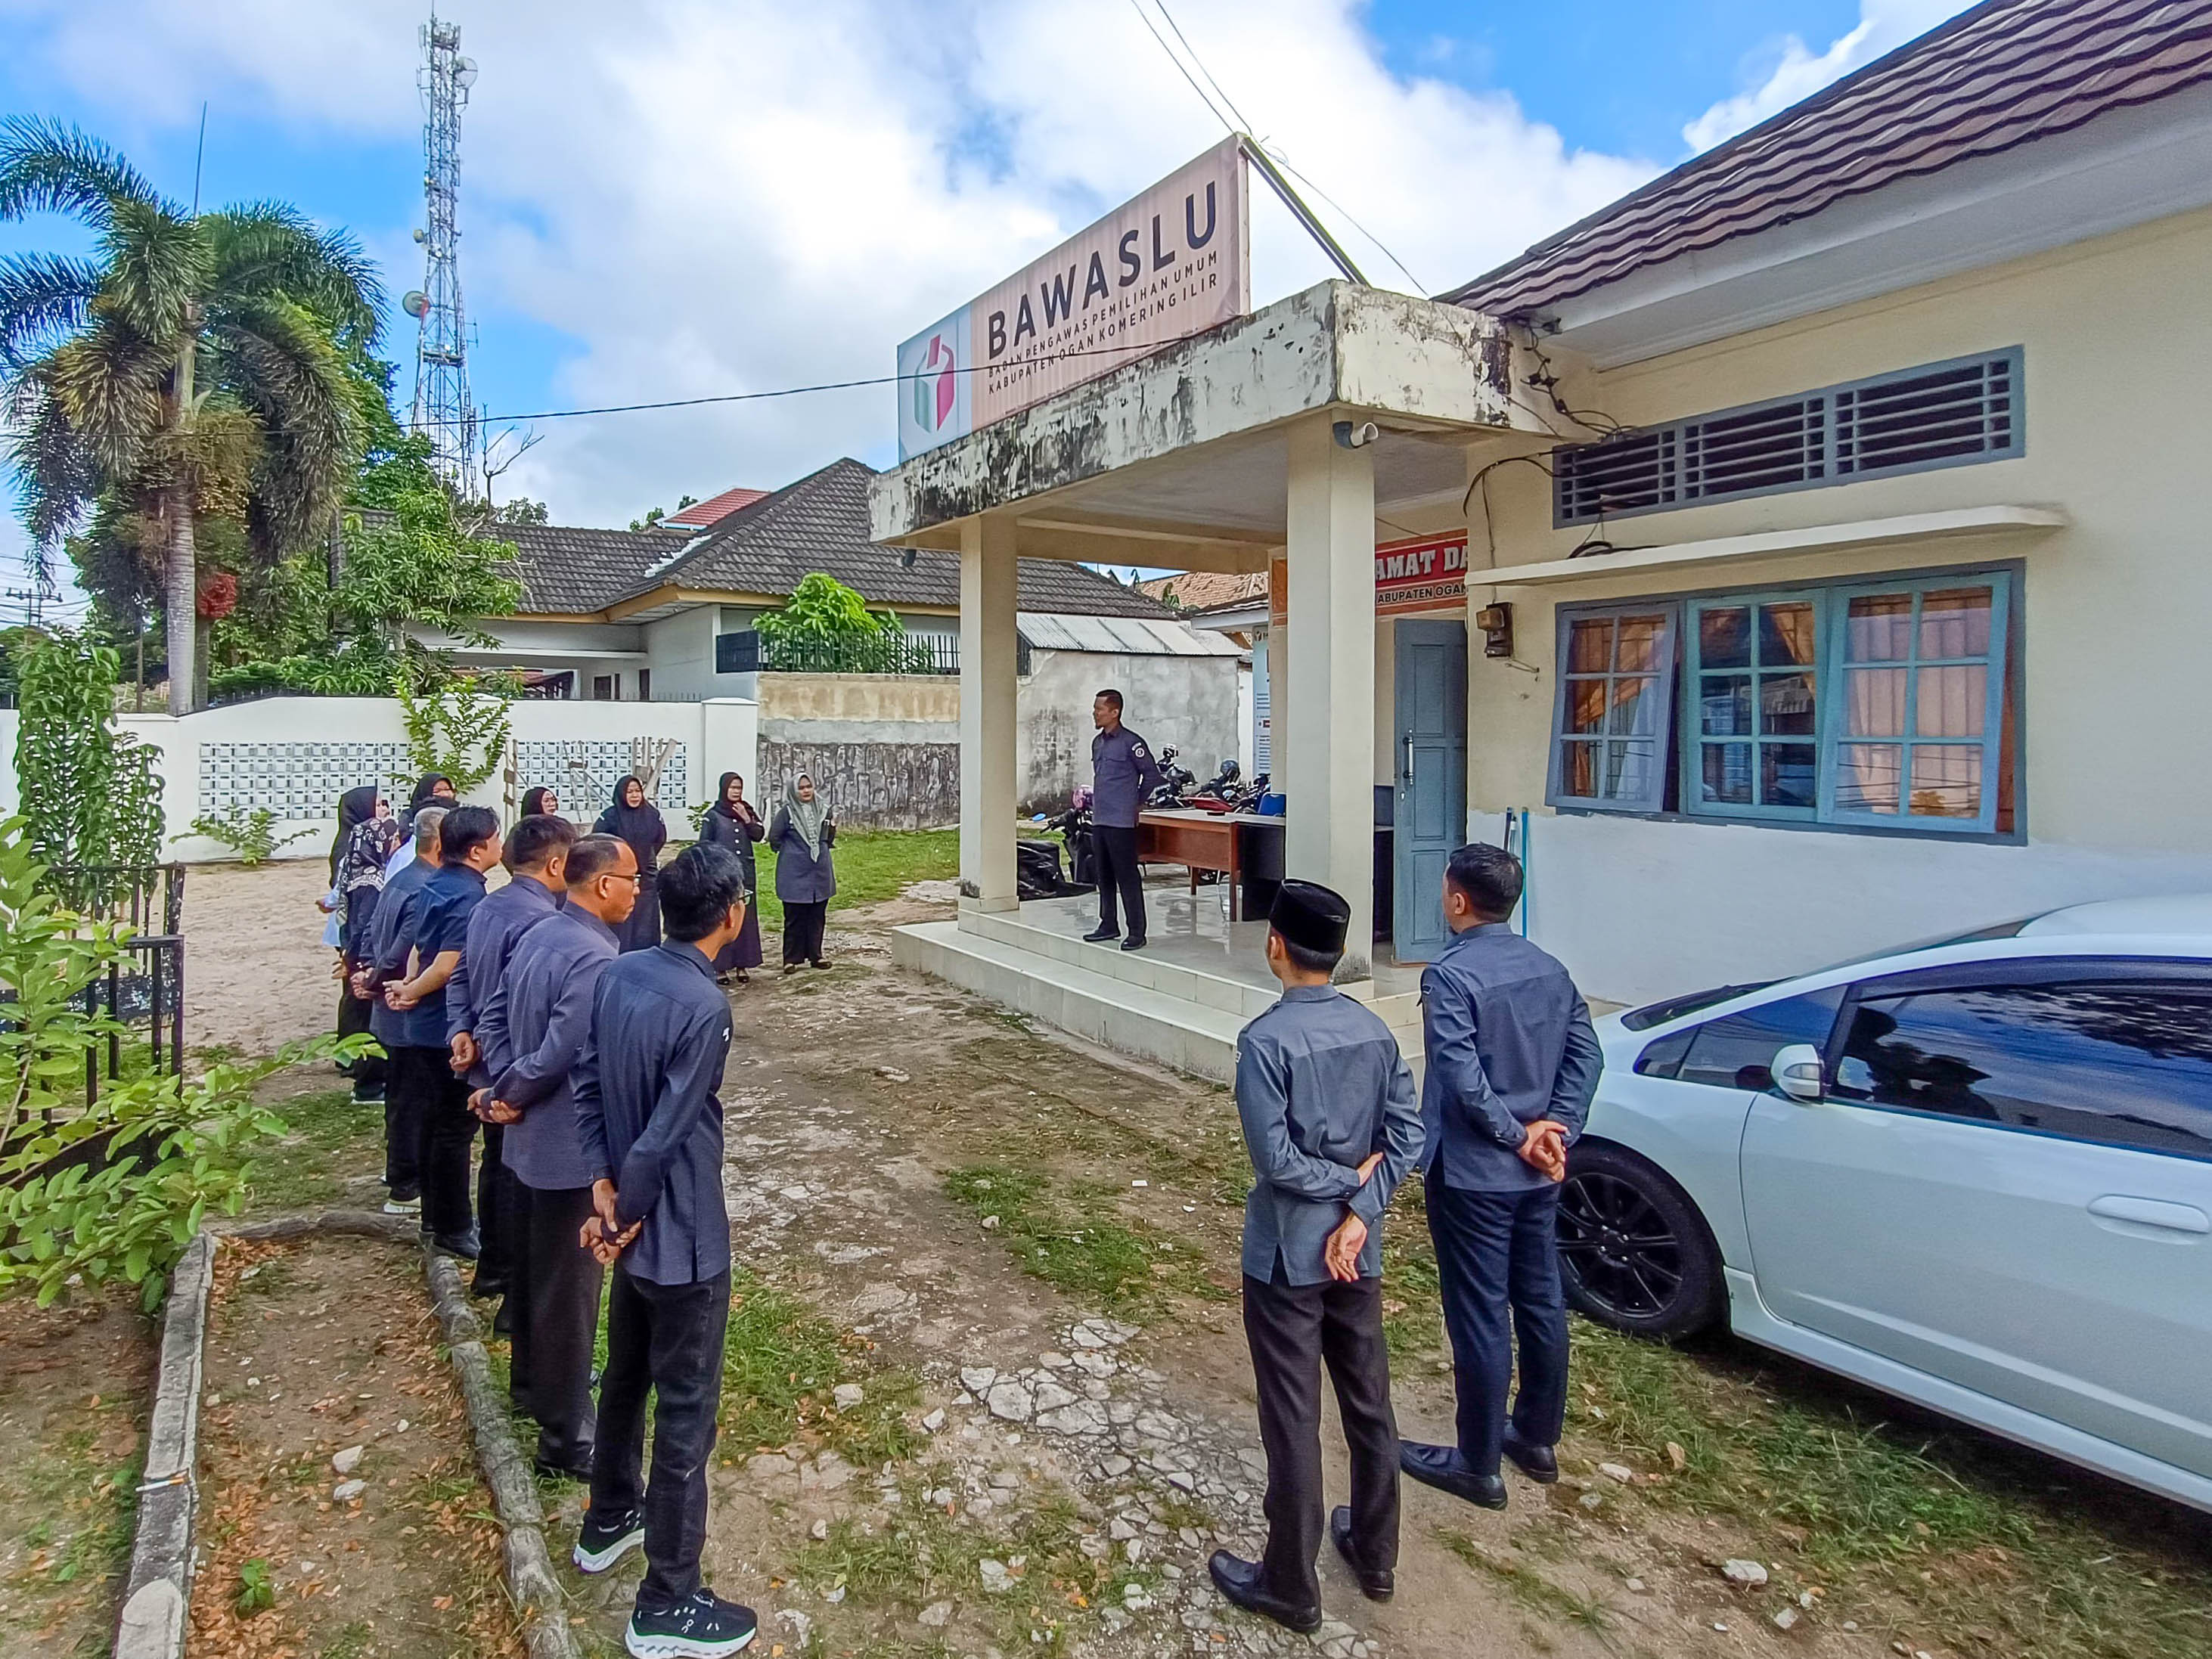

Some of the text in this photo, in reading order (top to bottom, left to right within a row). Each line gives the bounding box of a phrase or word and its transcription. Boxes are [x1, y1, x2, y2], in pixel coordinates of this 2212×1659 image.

[988, 181, 1216, 361] BAWASLU
[988, 352, 1022, 378] BADAN
[1025, 318, 1087, 359] PENGAWAS
[1092, 276, 1168, 326] PEMILIHAN
[1174, 250, 1217, 284] UMUM
[988, 273, 1217, 395] KABUPATEN OGAN KOMERING ILIR
